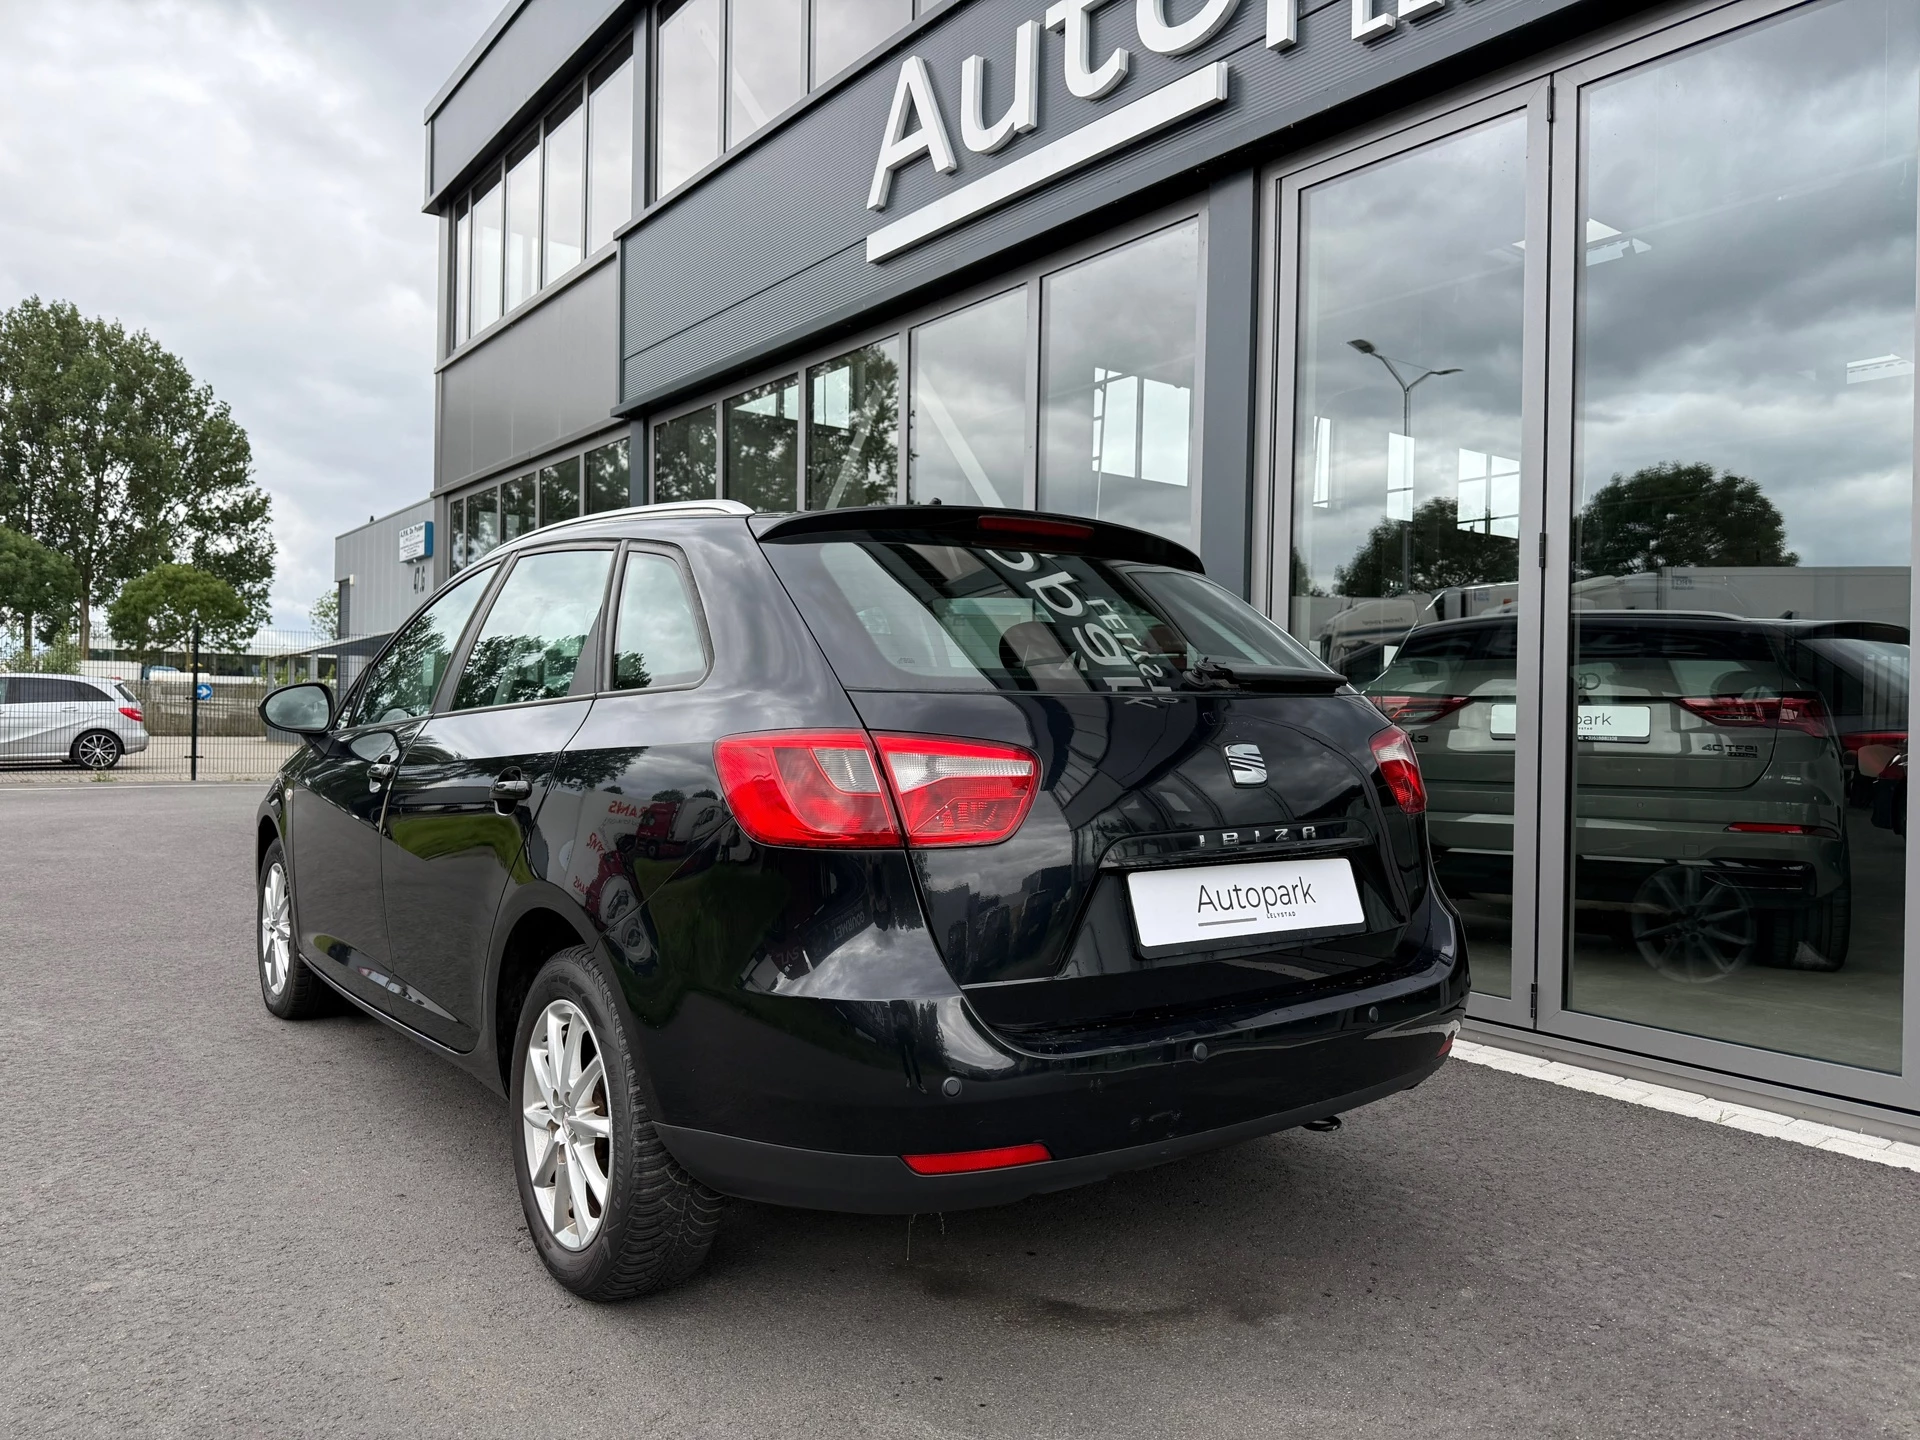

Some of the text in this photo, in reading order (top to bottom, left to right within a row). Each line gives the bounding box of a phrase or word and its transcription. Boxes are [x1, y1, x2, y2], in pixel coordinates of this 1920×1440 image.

[866, 0, 1299, 212] Auto
[1701, 743, 1723, 752] 40
[1198, 826, 1316, 847] IBIZA
[1197, 876, 1316, 914] Autopark
[1266, 910, 1297, 919] LELYSTAD
